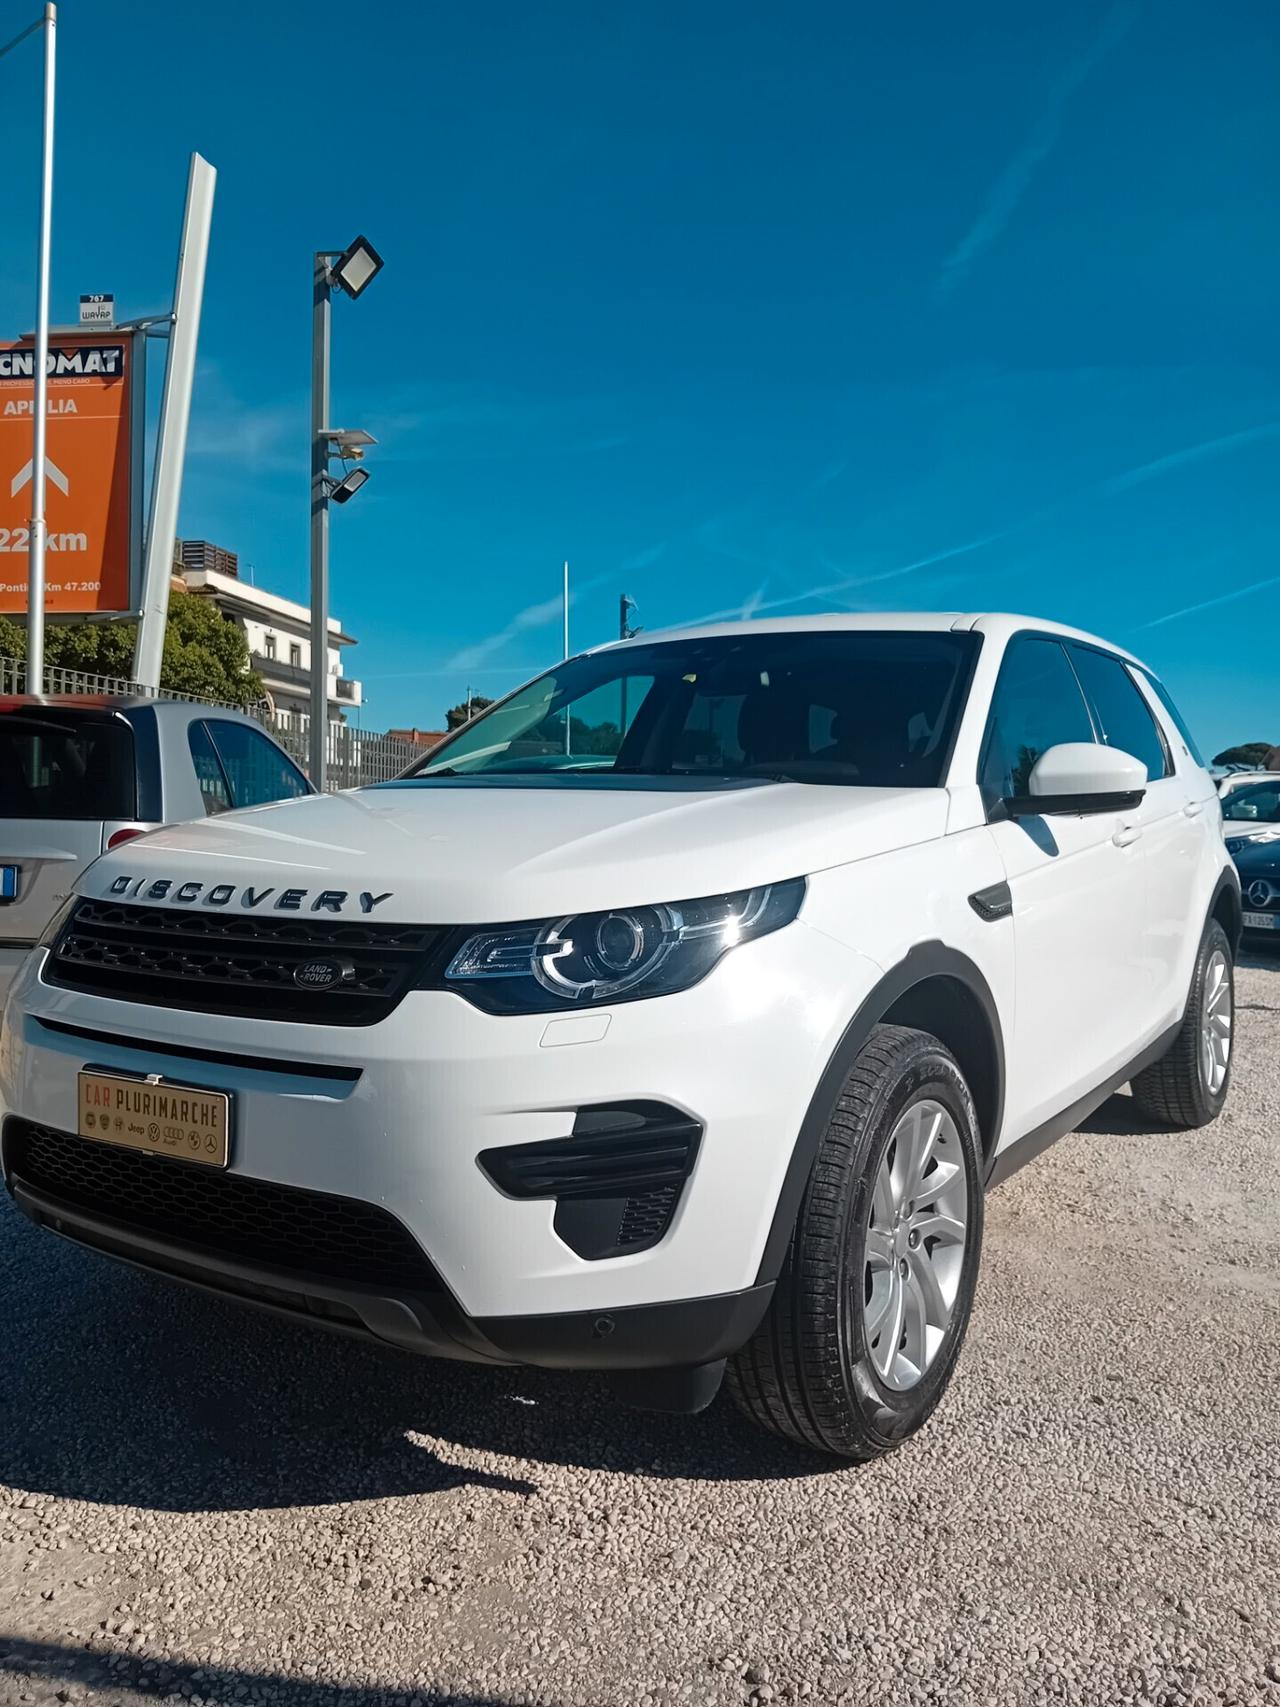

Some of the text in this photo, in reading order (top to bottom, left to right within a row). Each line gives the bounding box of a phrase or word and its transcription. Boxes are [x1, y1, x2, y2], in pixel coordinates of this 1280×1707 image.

[4, 399, 78, 415] APLIA
[45, 528, 87, 551] km
[0, 582, 101, 592] Ponti Km 47.200
[110, 876, 394, 913] DISCOVERY
[303, 972, 332, 983] ROVER
[86, 1084, 217, 1127] CAR PLURIMARCHE
[128, 1123, 145, 1135] Jeep
